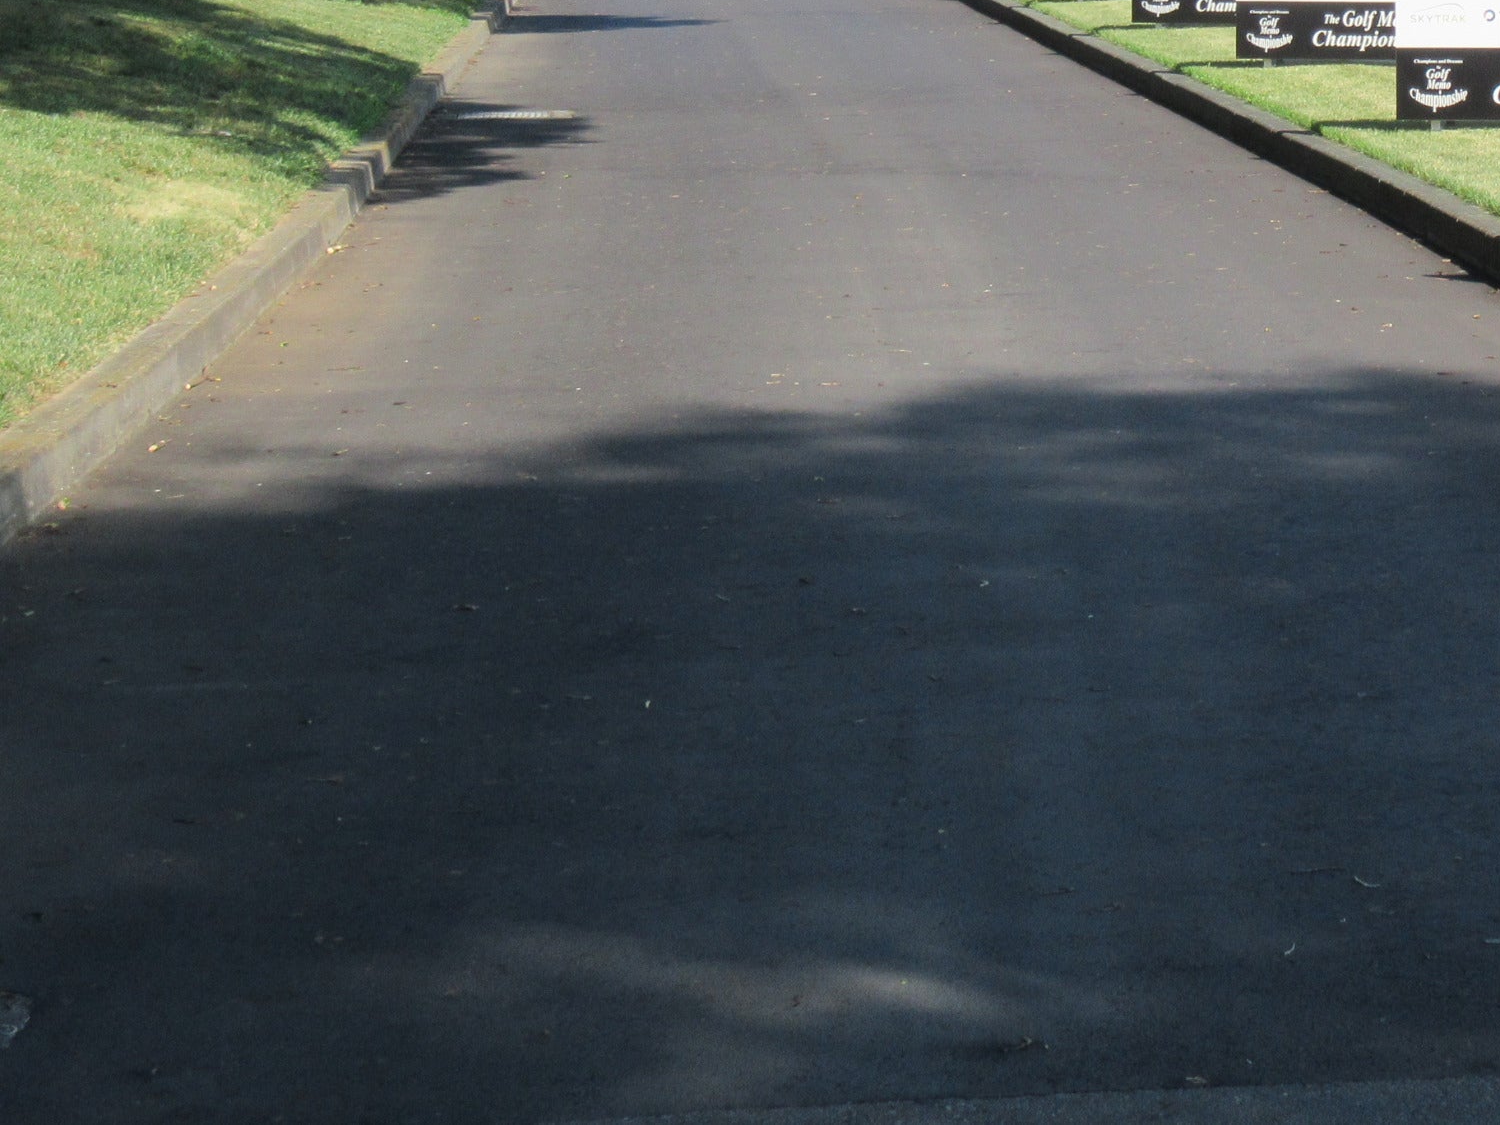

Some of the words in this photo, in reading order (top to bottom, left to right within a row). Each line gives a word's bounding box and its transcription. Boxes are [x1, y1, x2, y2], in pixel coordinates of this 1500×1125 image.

[1324, 14, 1340, 25] The
[1342, 10, 1377, 31] Golf
[1410, 14, 1467, 24] SKYTRAK
[1425, 68, 1452, 82] Golf
[1426, 79, 1452, 90] Memo
[1409, 87, 1468, 113] Championship
